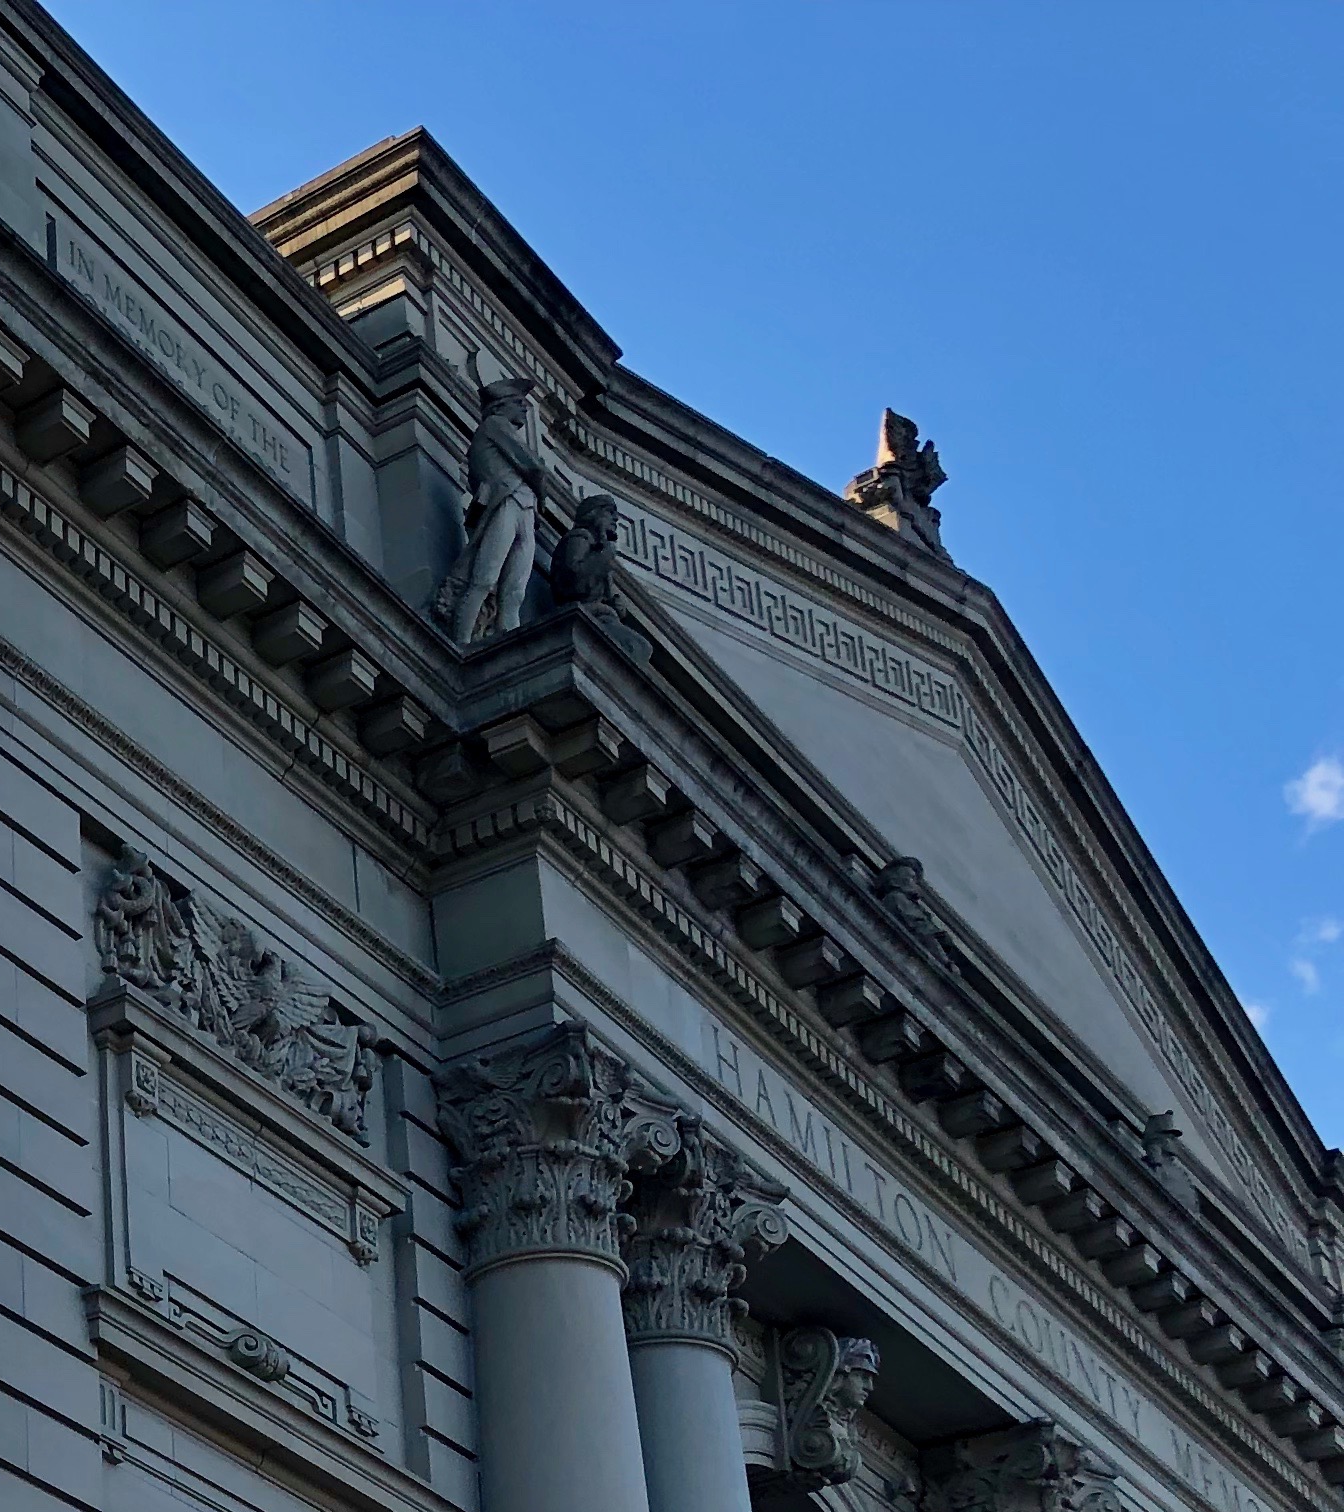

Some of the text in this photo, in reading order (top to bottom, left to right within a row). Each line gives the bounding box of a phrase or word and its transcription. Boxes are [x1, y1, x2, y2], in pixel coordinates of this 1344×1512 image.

[68, 240, 96, 283] IN
[104, 273, 209, 390] MEMORY
[213, 383, 241, 421] OF
[248, 412, 291, 474] THE
[711, 1024, 958, 1283] HAMILTON
[988, 1275, 1144, 1439] COUNTY
